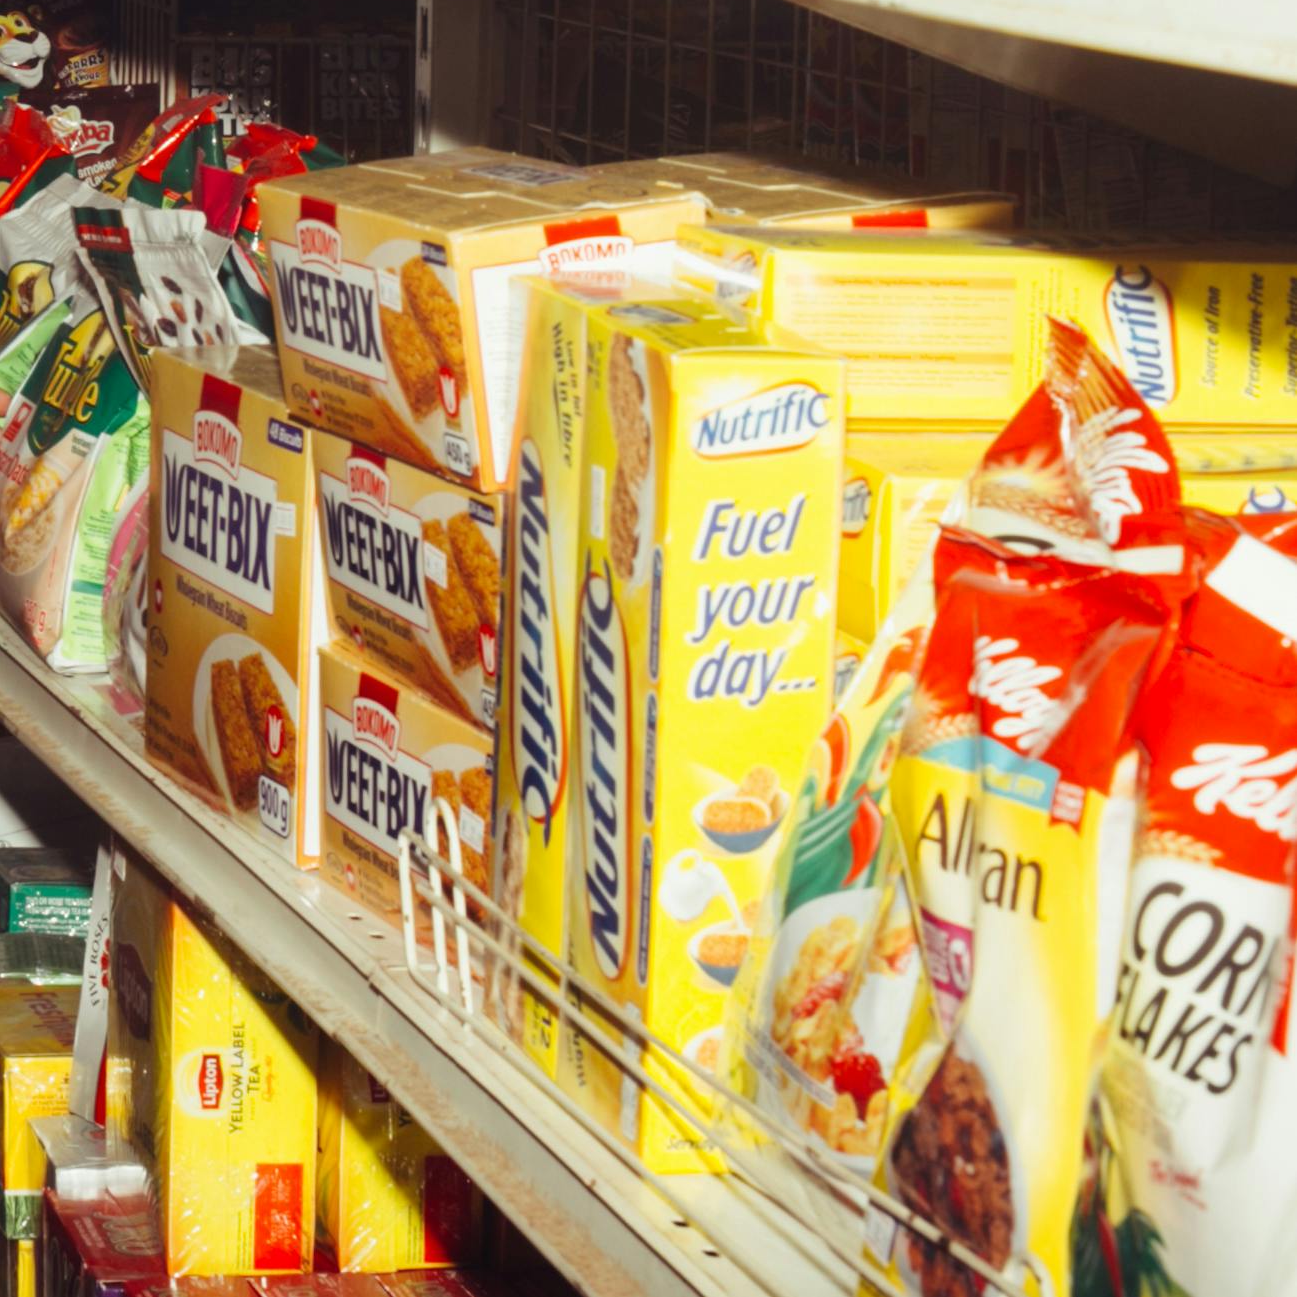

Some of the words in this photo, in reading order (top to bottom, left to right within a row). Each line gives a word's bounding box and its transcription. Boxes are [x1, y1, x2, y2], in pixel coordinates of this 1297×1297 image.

[298, 227, 339, 262] BOKOMO
[275, 260, 383, 362] WEET-BIX
[1114, 262, 1168, 404] Nutrific
[195, 419, 241, 468] BOKOMO
[695, 390, 833, 452] Nutrific
[163, 452, 272, 592] WEET-BIX
[347, 473, 389, 510] BOKOMO
[322, 491, 425, 611] WEET-BIX
[693, 494, 807, 562] Fuel
[688, 576, 817, 642] your
[517, 449, 555, 849] Nutrific
[353, 706, 399, 752] BOKOMO
[259, 781, 279, 817] 900
[232, 1021, 246, 1065] LABEL
[202, 1057, 218, 1107] Lipton
[228, 1067, 246, 1135] YELLOW
[249, 1064, 261, 1092] TEA
